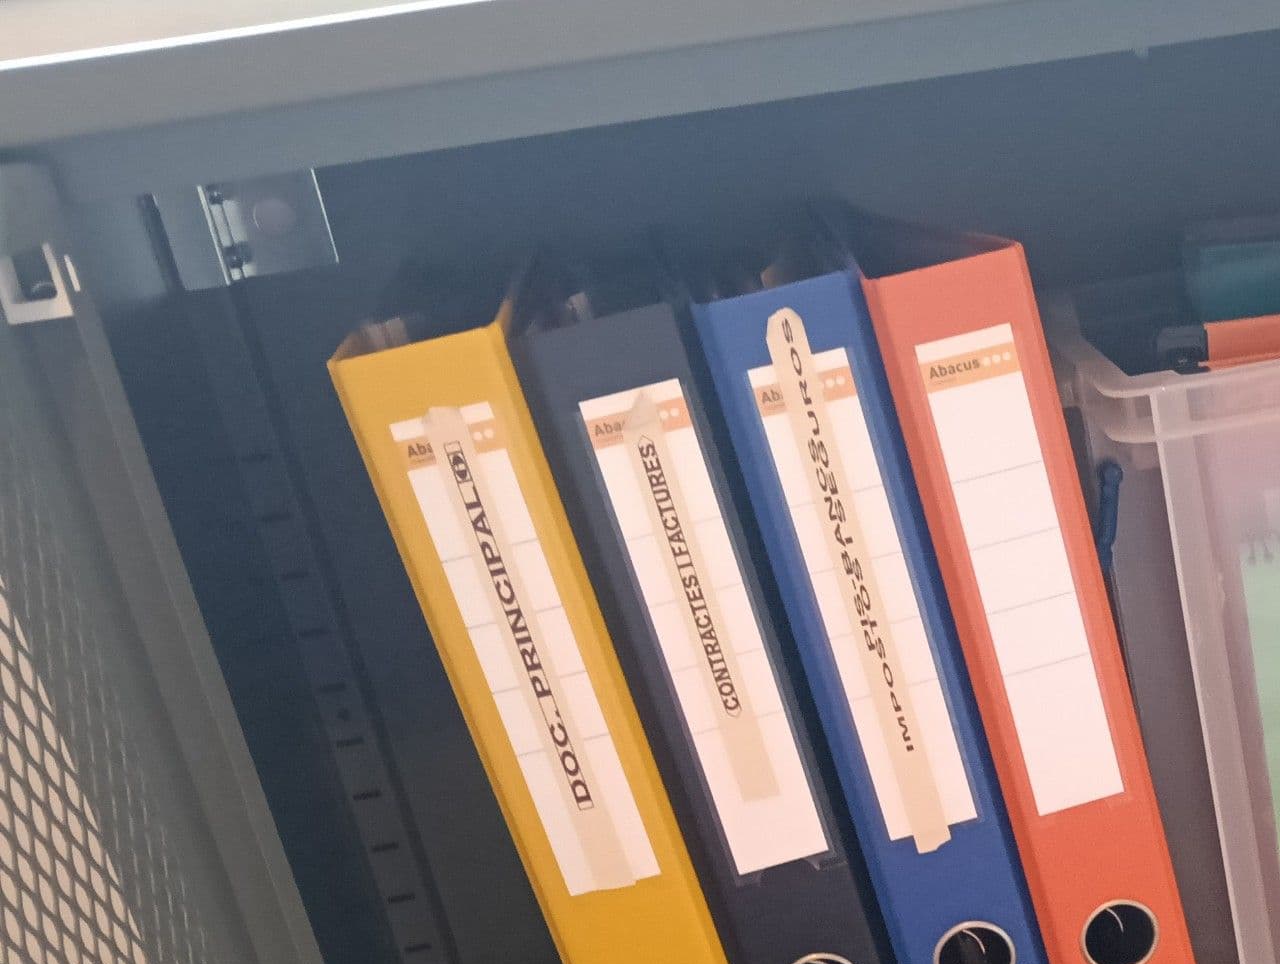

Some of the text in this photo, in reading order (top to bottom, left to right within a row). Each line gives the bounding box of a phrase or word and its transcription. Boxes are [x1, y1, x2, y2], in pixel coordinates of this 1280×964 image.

[782, 318, 847, 523] SEGUROS
[929, 358, 981, 380] Abacus
[638, 442, 691, 559] FACTURES
[807, 438, 876, 652] PIS-BANCS
[465, 486, 593, 808] DOC. PRINCIPAL
[683, 575, 741, 712] CONTRACTES
[851, 557, 914, 752] IMPOSTOS
